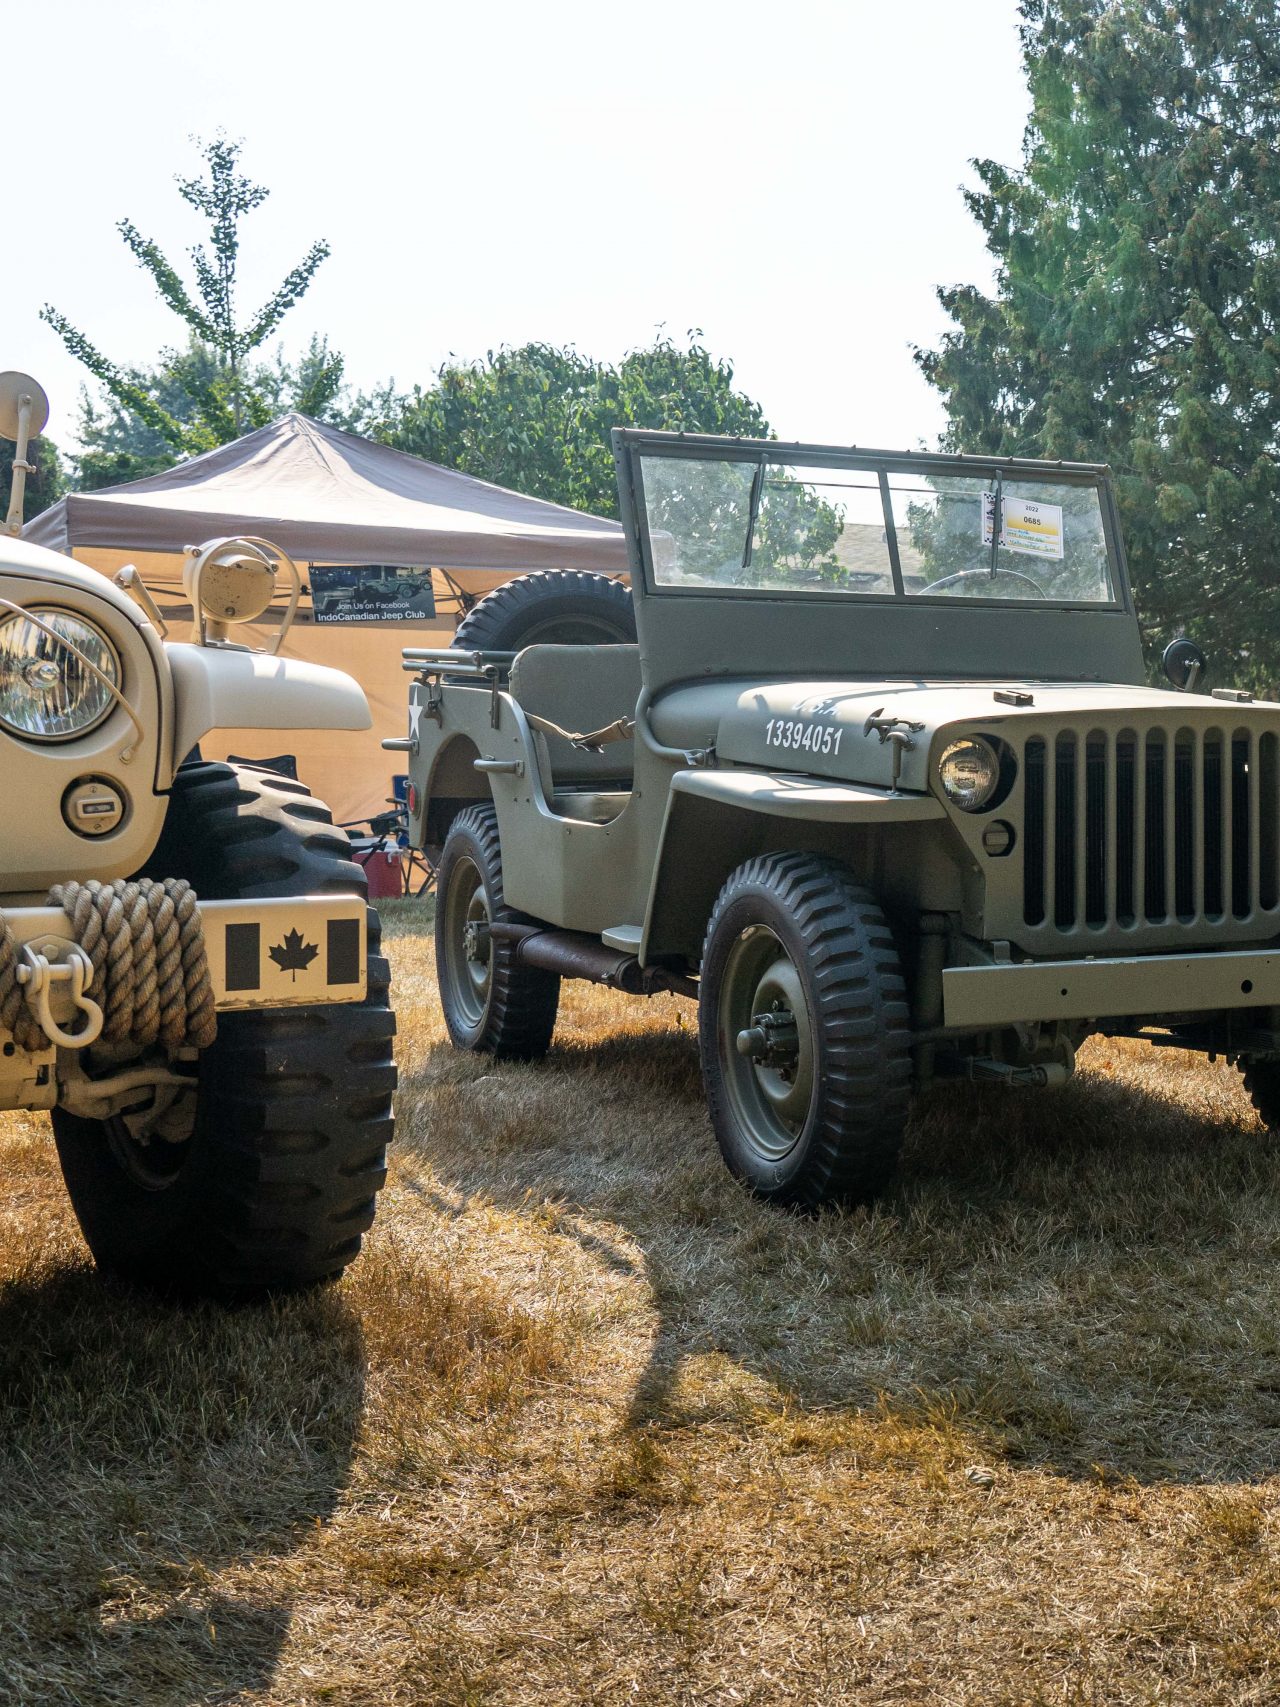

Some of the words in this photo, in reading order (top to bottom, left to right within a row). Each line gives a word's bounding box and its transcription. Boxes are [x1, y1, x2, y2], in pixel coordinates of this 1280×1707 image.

[1025, 505, 1039, 513] 2022
[1023, 516, 1041, 526] 0685
[336, 602, 352, 610] Join
[353, 602, 363, 610] Us
[376, 601, 411, 609] Facebook
[317, 612, 380, 621] IndoCanadian
[381, 611, 403, 621] Jeep
[405, 611, 426, 619] Club
[766, 719, 843, 755] 13394051
